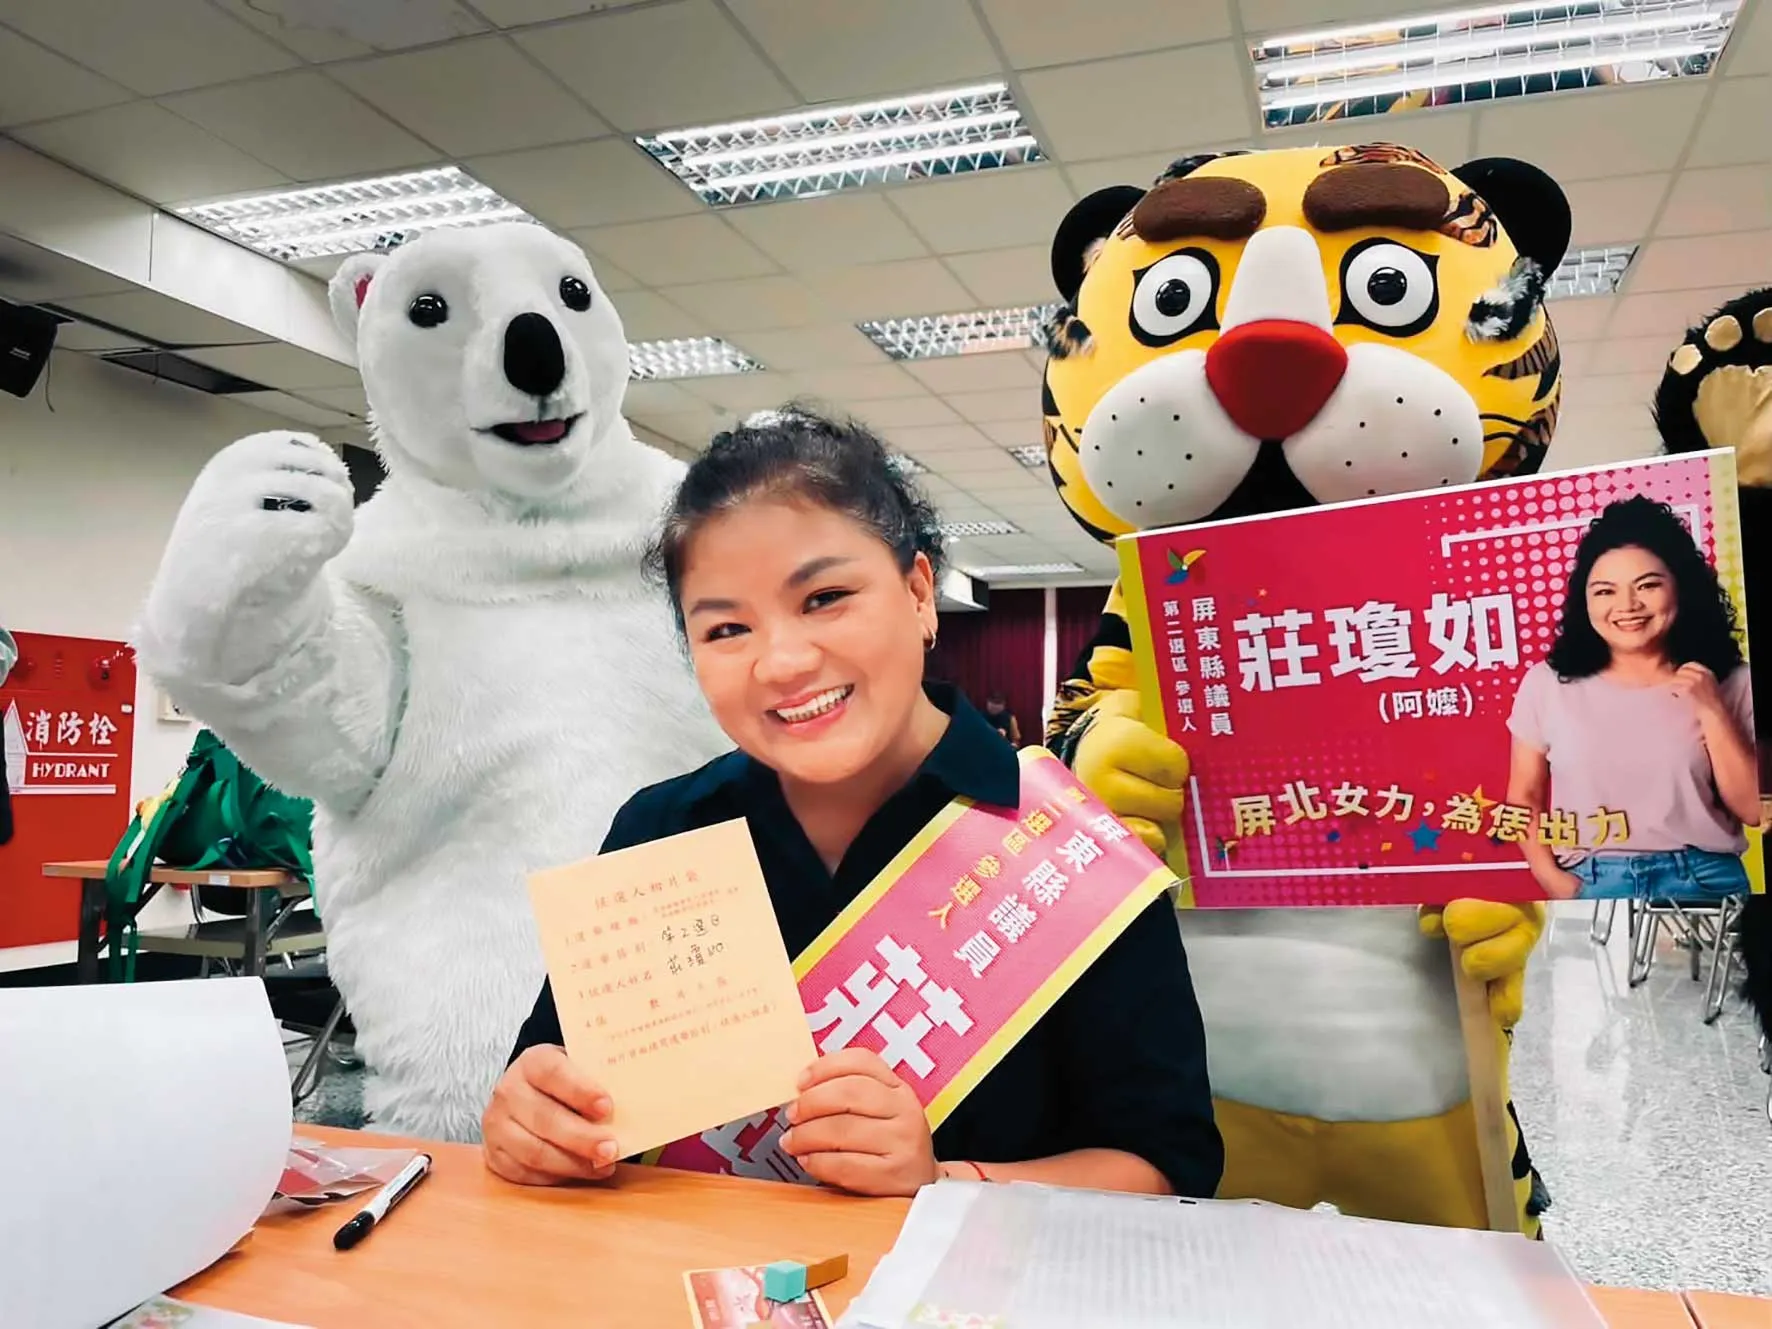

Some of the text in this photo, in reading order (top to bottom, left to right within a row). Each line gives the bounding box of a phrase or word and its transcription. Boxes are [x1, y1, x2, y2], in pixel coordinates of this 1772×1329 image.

[1163, 600, 1197, 732] 第二選區 參選人
[1191, 597, 1234, 736] 屏東縣議員
[1233, 593, 1519, 692] 莊瓊如
[26, 709, 118, 750] 消防栓
[1378, 686, 1473, 723] (阿嬤)
[32, 762, 109, 778] HYDRANT
[927, 855, 1001, 930] 參選人
[953, 813, 1131, 979] 屏東縣議員
